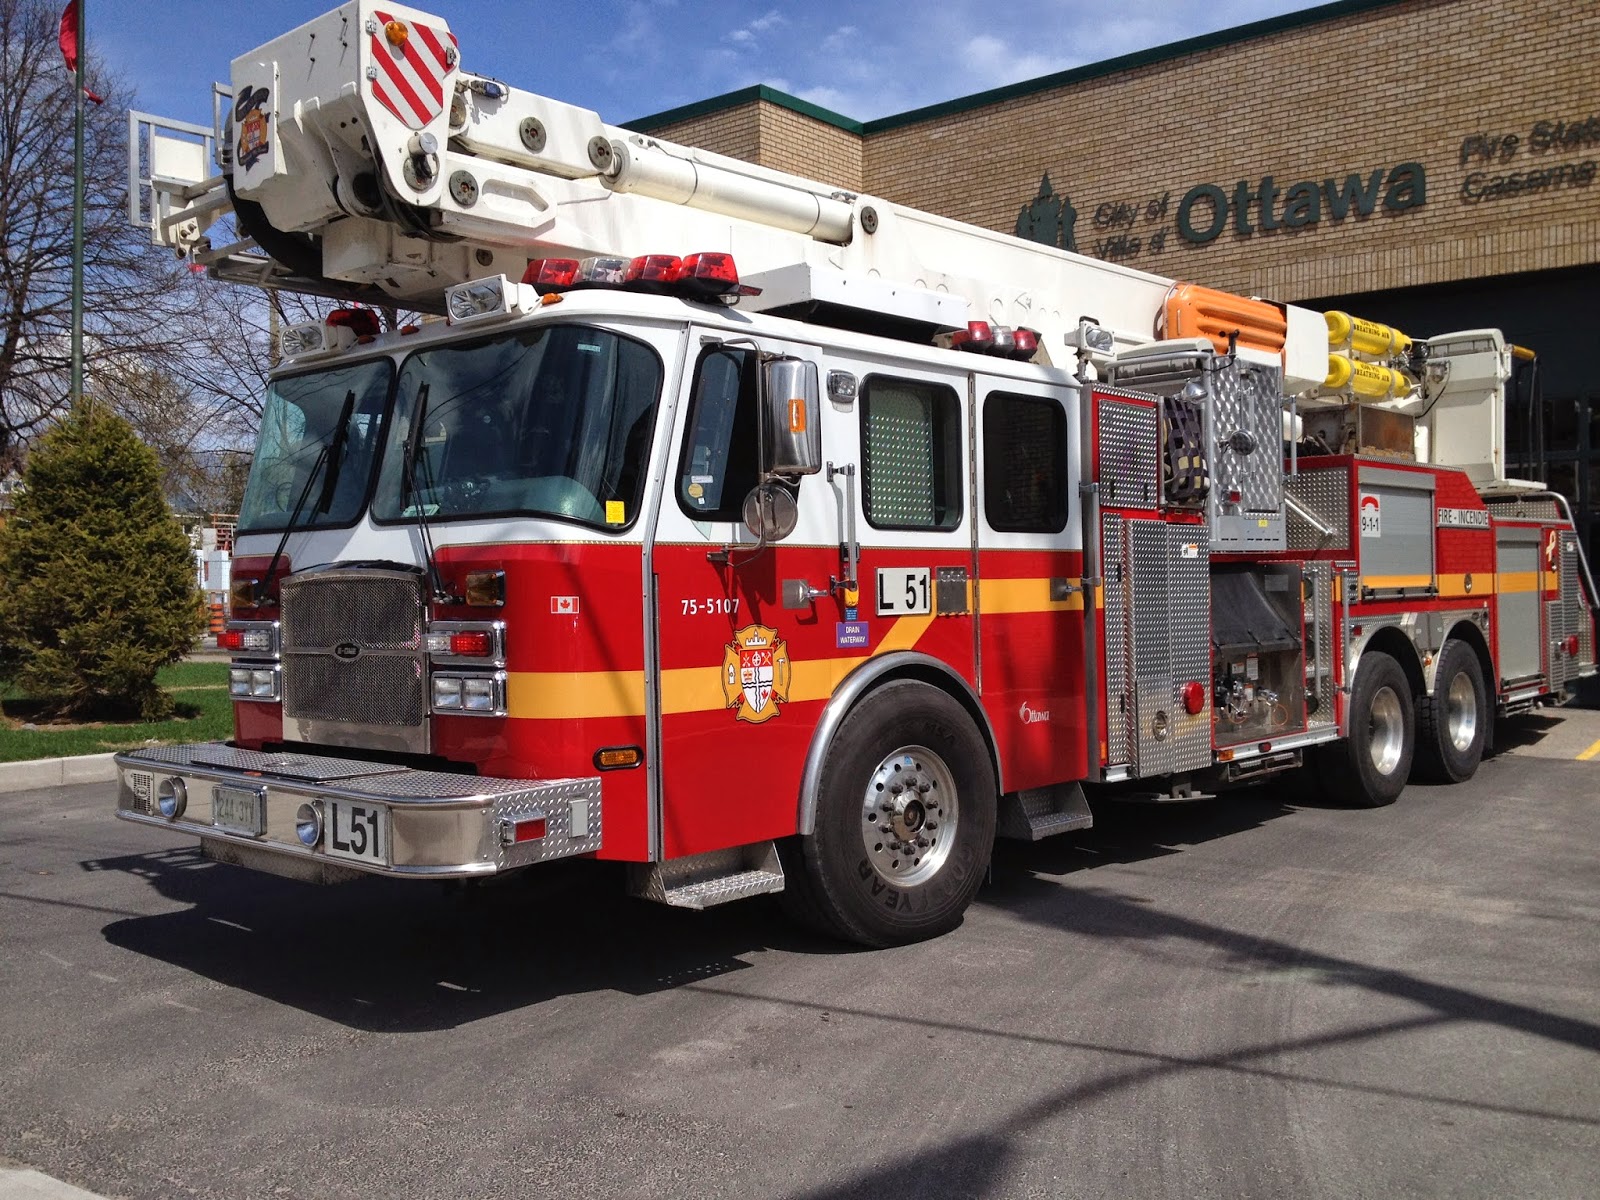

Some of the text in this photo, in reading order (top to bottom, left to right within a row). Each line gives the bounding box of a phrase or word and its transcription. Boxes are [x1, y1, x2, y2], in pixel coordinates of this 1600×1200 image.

[1462, 133, 1519, 166] Fire
[1464, 161, 1597, 198] Caserne
[1095, 192, 1169, 230] City of
[1177, 162, 1426, 242] Ottawa
[1096, 234, 1141, 259] Ville
[1353, 323, 1380, 337] BREATHING
[1382, 331, 1390, 340] AIR
[1382, 374, 1390, 382] AIR
[1362, 516, 1379, 532] 9-1-1
[1438, 509, 1452, 523] FIRE
[1459, 511, 1488, 526] INCENDIE
[879, 573, 927, 610] L 51
[681, 598, 740, 615] 75-5107
[840, 636, 866, 644] WATERWAY
[845, 626, 860, 634] DRAIN
[1019, 701, 1050, 725] Ottawa
[332, 802, 379, 858] L51
